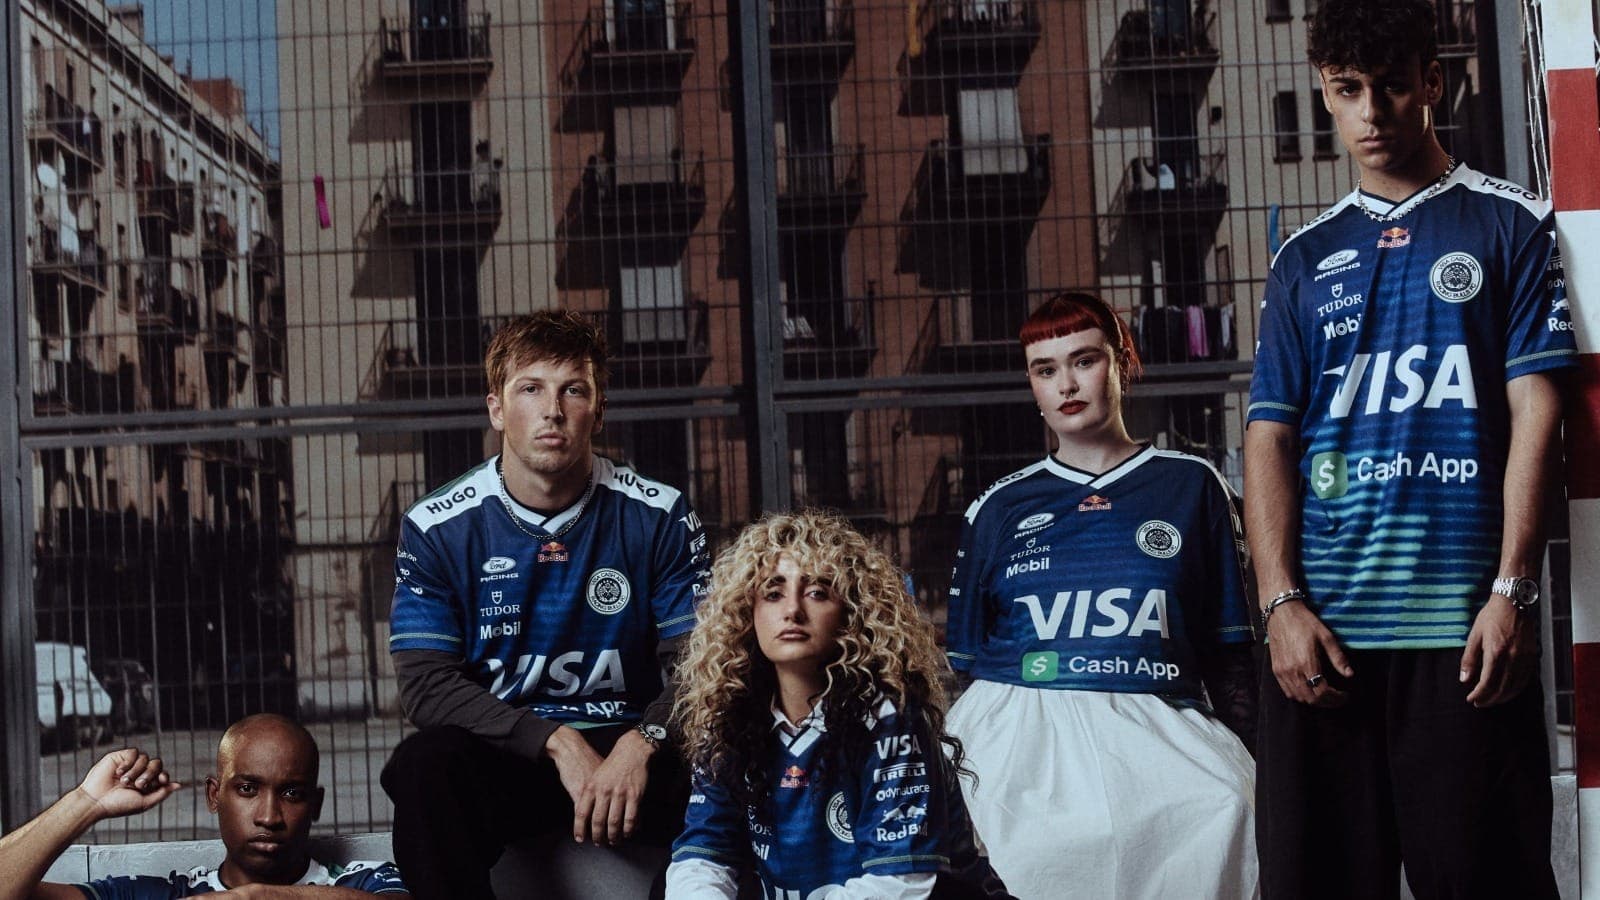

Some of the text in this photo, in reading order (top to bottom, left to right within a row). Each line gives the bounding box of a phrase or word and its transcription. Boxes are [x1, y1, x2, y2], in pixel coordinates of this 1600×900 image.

[1314, 261, 1361, 281] RACING
[1317, 293, 1364, 317] TUDOR
[1322, 344, 1478, 419] VISA
[1357, 452, 1412, 482] Cash
[1418, 452, 1479, 484] App
[426, 486, 476, 514] HUGO
[1010, 545, 1051, 561] TUDOR
[1005, 557, 1050, 579] Mobil
[480, 604, 521, 617] TUDOR
[1013, 587, 1170, 641] VISA
[480, 621, 521, 640] Mobil
[484, 649, 626, 700] VISA
[1068, 656, 1129, 674] Cash
[1134, 657, 1180, 681] App
[873, 734, 922, 760] VISA
[873, 762, 926, 783] PIRELLI
